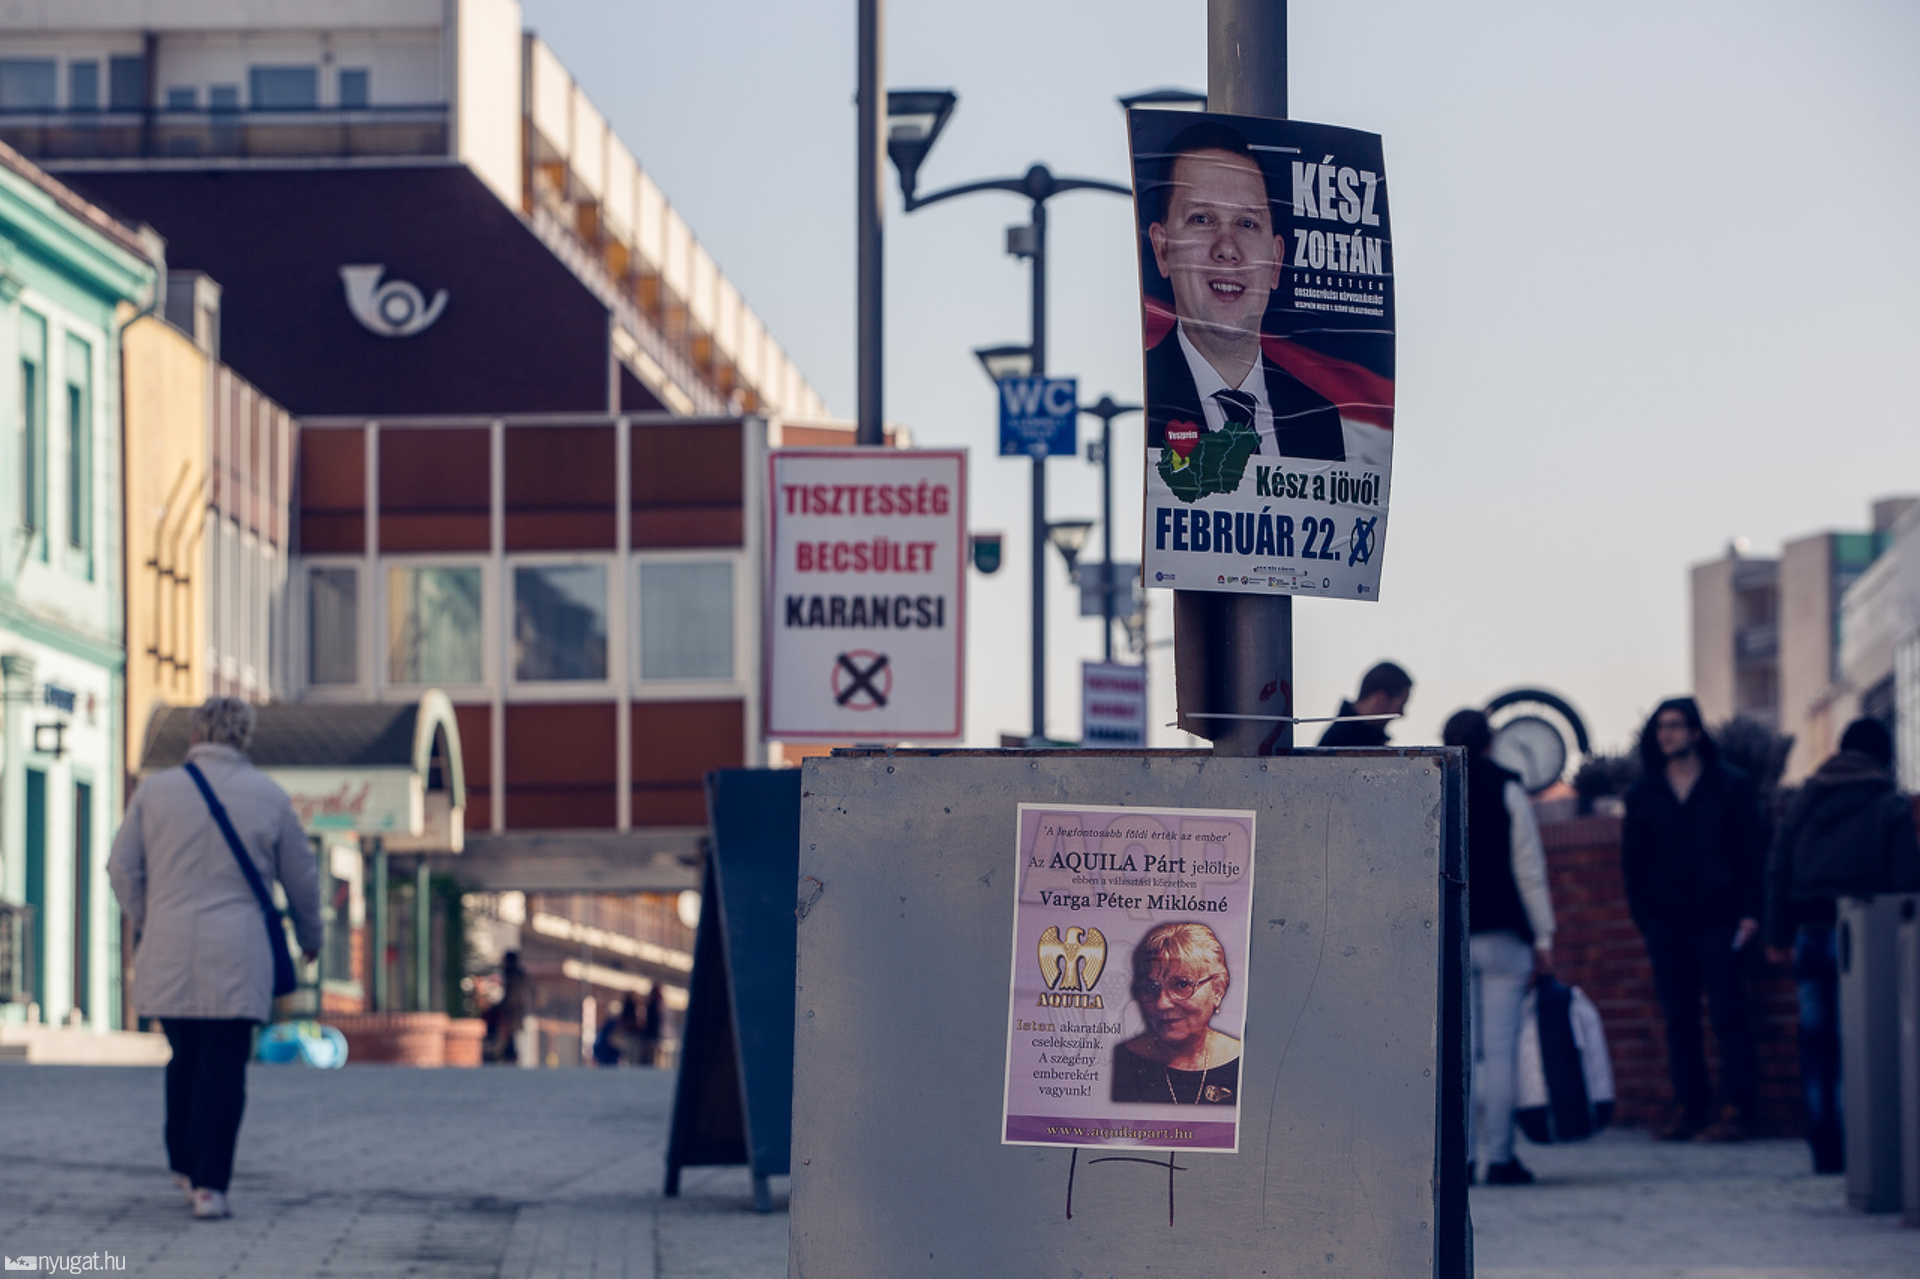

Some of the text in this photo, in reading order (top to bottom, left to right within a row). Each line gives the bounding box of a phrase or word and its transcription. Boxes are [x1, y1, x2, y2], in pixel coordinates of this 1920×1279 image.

[1292, 154, 1380, 226] KÉSZ
[1294, 228, 1383, 275] ZOLTÁN
[1003, 380, 1073, 415] WC
[782, 478, 950, 517] TISZTESSÉG
[1256, 465, 1380, 506] Kész a jövő!
[1156, 506, 1341, 561] FEBRUÁR 22.
[795, 535, 938, 574] BECSÜLET
[785, 595, 946, 629] KARANCSI
[1028, 851, 1240, 878] Az AQUILA Párt jelöltje
[1040, 890, 1228, 913] Varga Péter Miklósné
[1036, 992, 1104, 1010] AQUILA
[1060, 1021, 1121, 1035] akaratából
[1031, 1036, 1104, 1049] cselekszünk.
[1038, 1052, 1096, 1067] A szegény
[1033, 1068, 1099, 1081] emberekért
[1039, 1084, 1092, 1098] vagyunk!
[1047, 1125, 1194, 1140] www.aquilapart.hu
